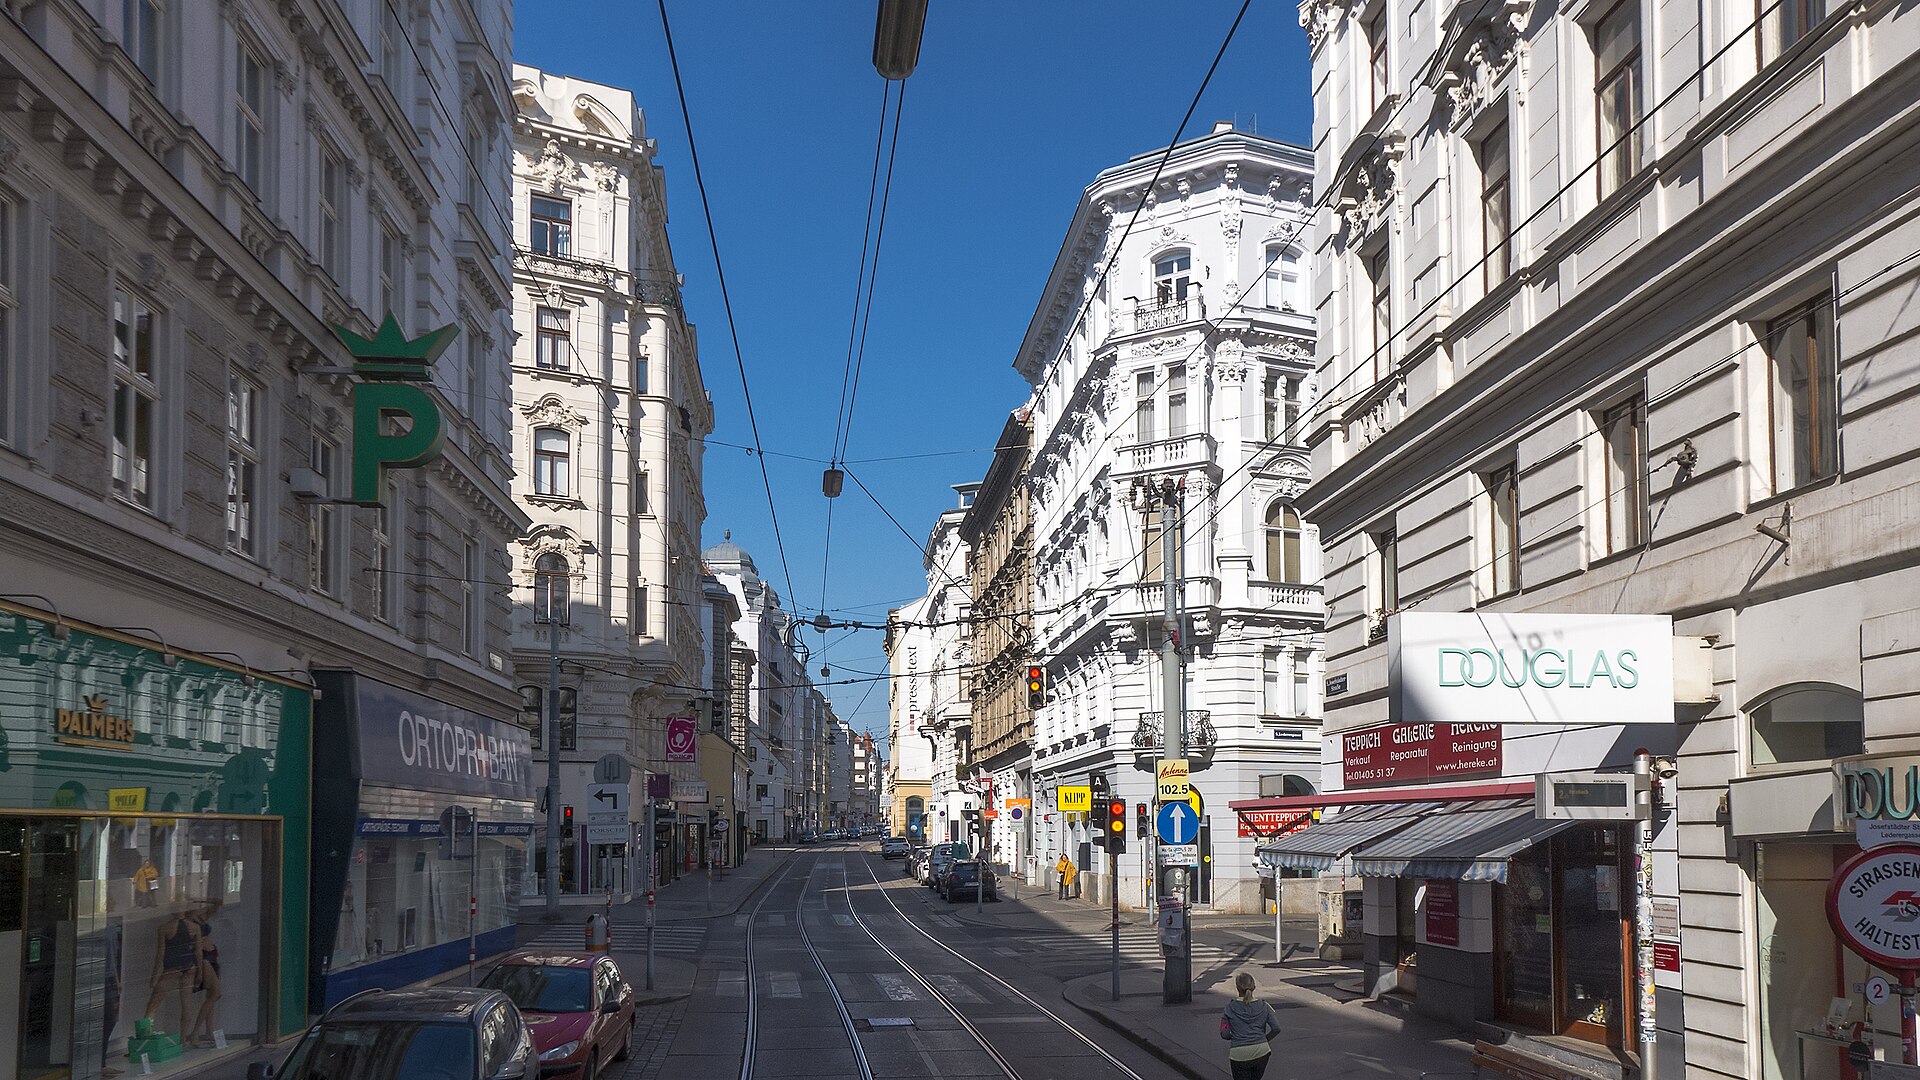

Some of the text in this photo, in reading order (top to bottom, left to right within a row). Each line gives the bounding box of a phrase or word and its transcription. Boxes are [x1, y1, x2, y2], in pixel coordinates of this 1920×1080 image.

[353, 383, 441, 503] P
[907, 646, 920, 712] pressetext
[1438, 648, 1639, 689] DOUGLAS
[57, 707, 135, 742] PALMERS
[1345, 732, 1381, 752] TEPPICH
[1393, 724, 1435, 744] GALERIE
[1345, 740, 1497, 767] Verkauf Reparatur Reinigung
[1435, 757, 1497, 771] www.hereke.at
[1094, 776, 1102, 786] A
[1159, 763, 1188, 779] Antenne
[1377, 769, 1384, 778] 51
[1386, 768, 1395, 777] 37
[1065, 792, 1086, 804] KLIPP
[1160, 784, 1189, 795] 102.5
[1843, 765, 1920, 820] DOU
[1873, 984, 1883, 999] 2
